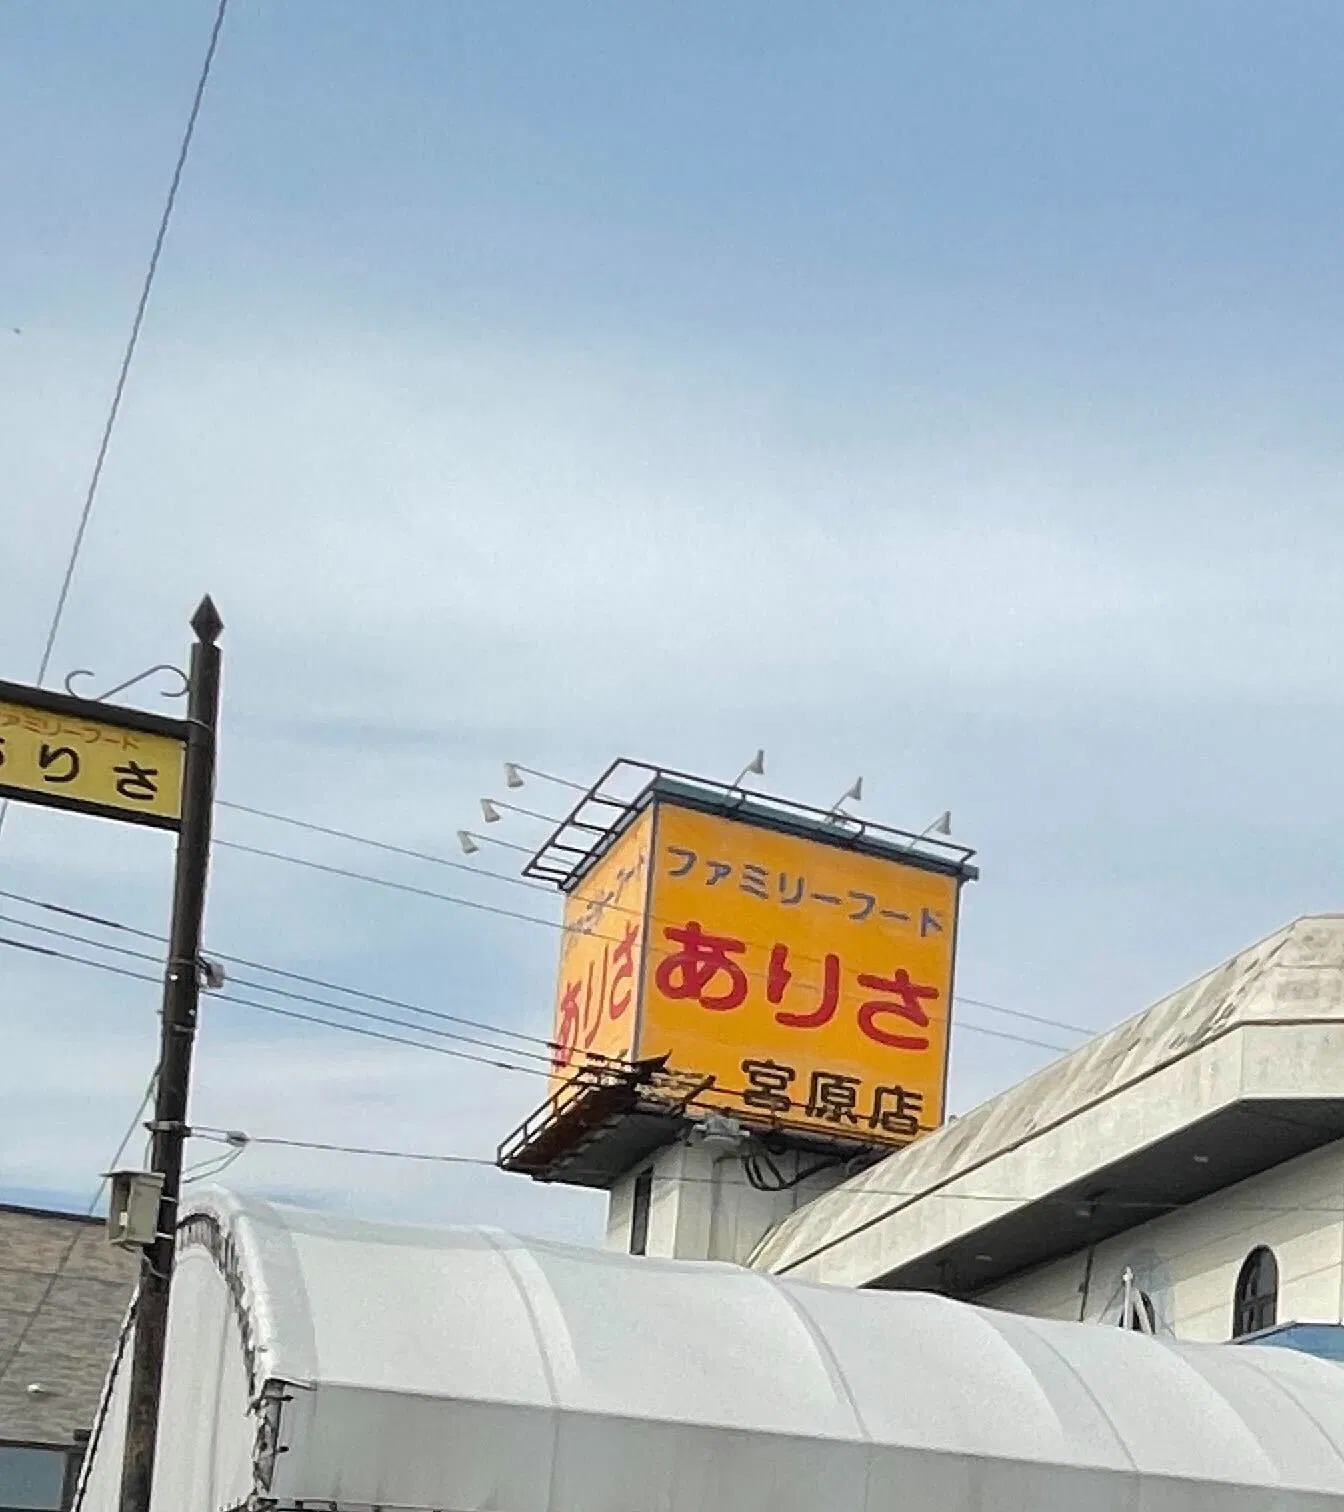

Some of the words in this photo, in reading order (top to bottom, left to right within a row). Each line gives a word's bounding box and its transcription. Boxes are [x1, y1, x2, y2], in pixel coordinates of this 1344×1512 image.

[0, 737, 158, 801] りさ
[666, 846, 945, 938] ファミリーフード
[654, 920, 940, 1050] ありさ
[740, 1058, 923, 1135] 宮原店
